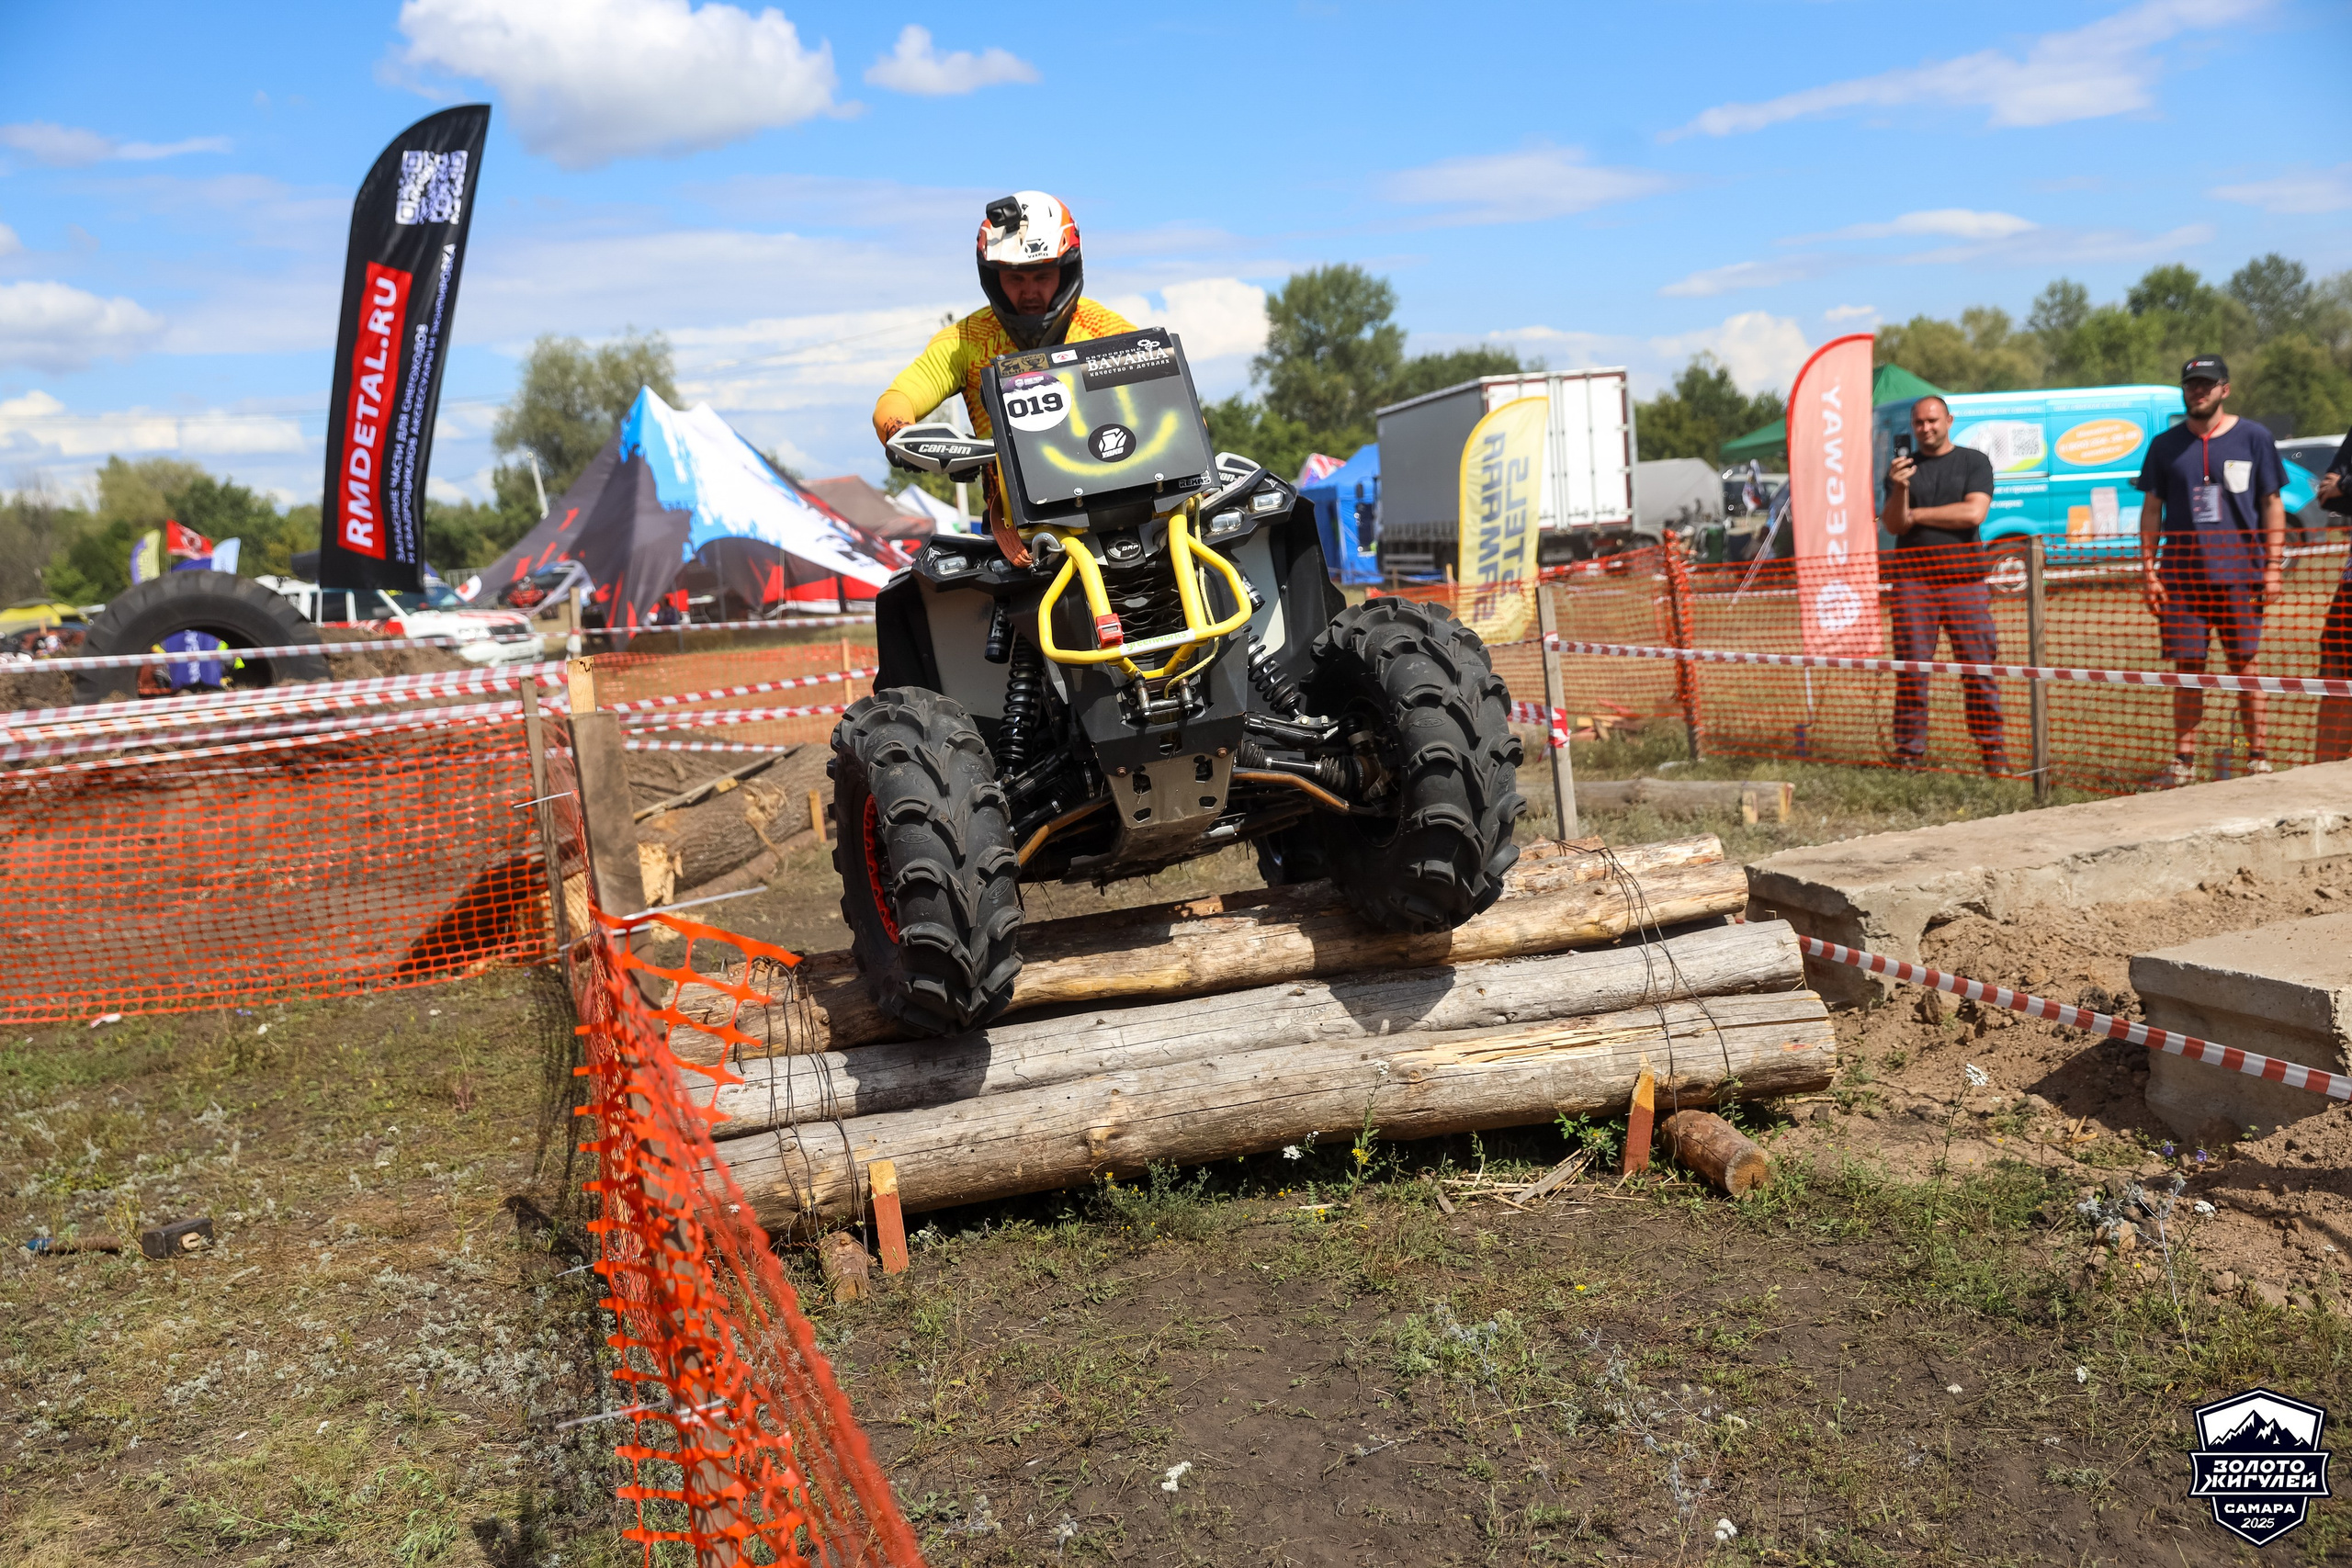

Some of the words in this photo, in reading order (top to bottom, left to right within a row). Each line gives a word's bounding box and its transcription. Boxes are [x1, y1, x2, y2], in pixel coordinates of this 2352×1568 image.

[430, 243, 457, 335] ЭКИПИРОВКА
[428, 336, 437, 349] И
[1085, 347, 1141, 360] автосервис
[401, 323, 429, 412] СНЕГОХОДОВ
[1086, 347, 1169, 371] BAVARIA
[1090, 367, 1126, 377] качество
[1136, 359, 1170, 369] деталях
[410, 350, 435, 436] АКСЕССУАРЫ
[1007, 392, 1064, 419] 019
[345, 276, 399, 550] RMDETAL.RU
[395, 413, 410, 443] ДЛЯ
[918, 444, 972, 455] can-am
[1102, 446, 1125, 458] YOKO
[390, 443, 405, 488] ЧАСТИ
[389, 489, 406, 563] ЗАПАСНЫЕ
[1121, 544, 1139, 552] BRP
